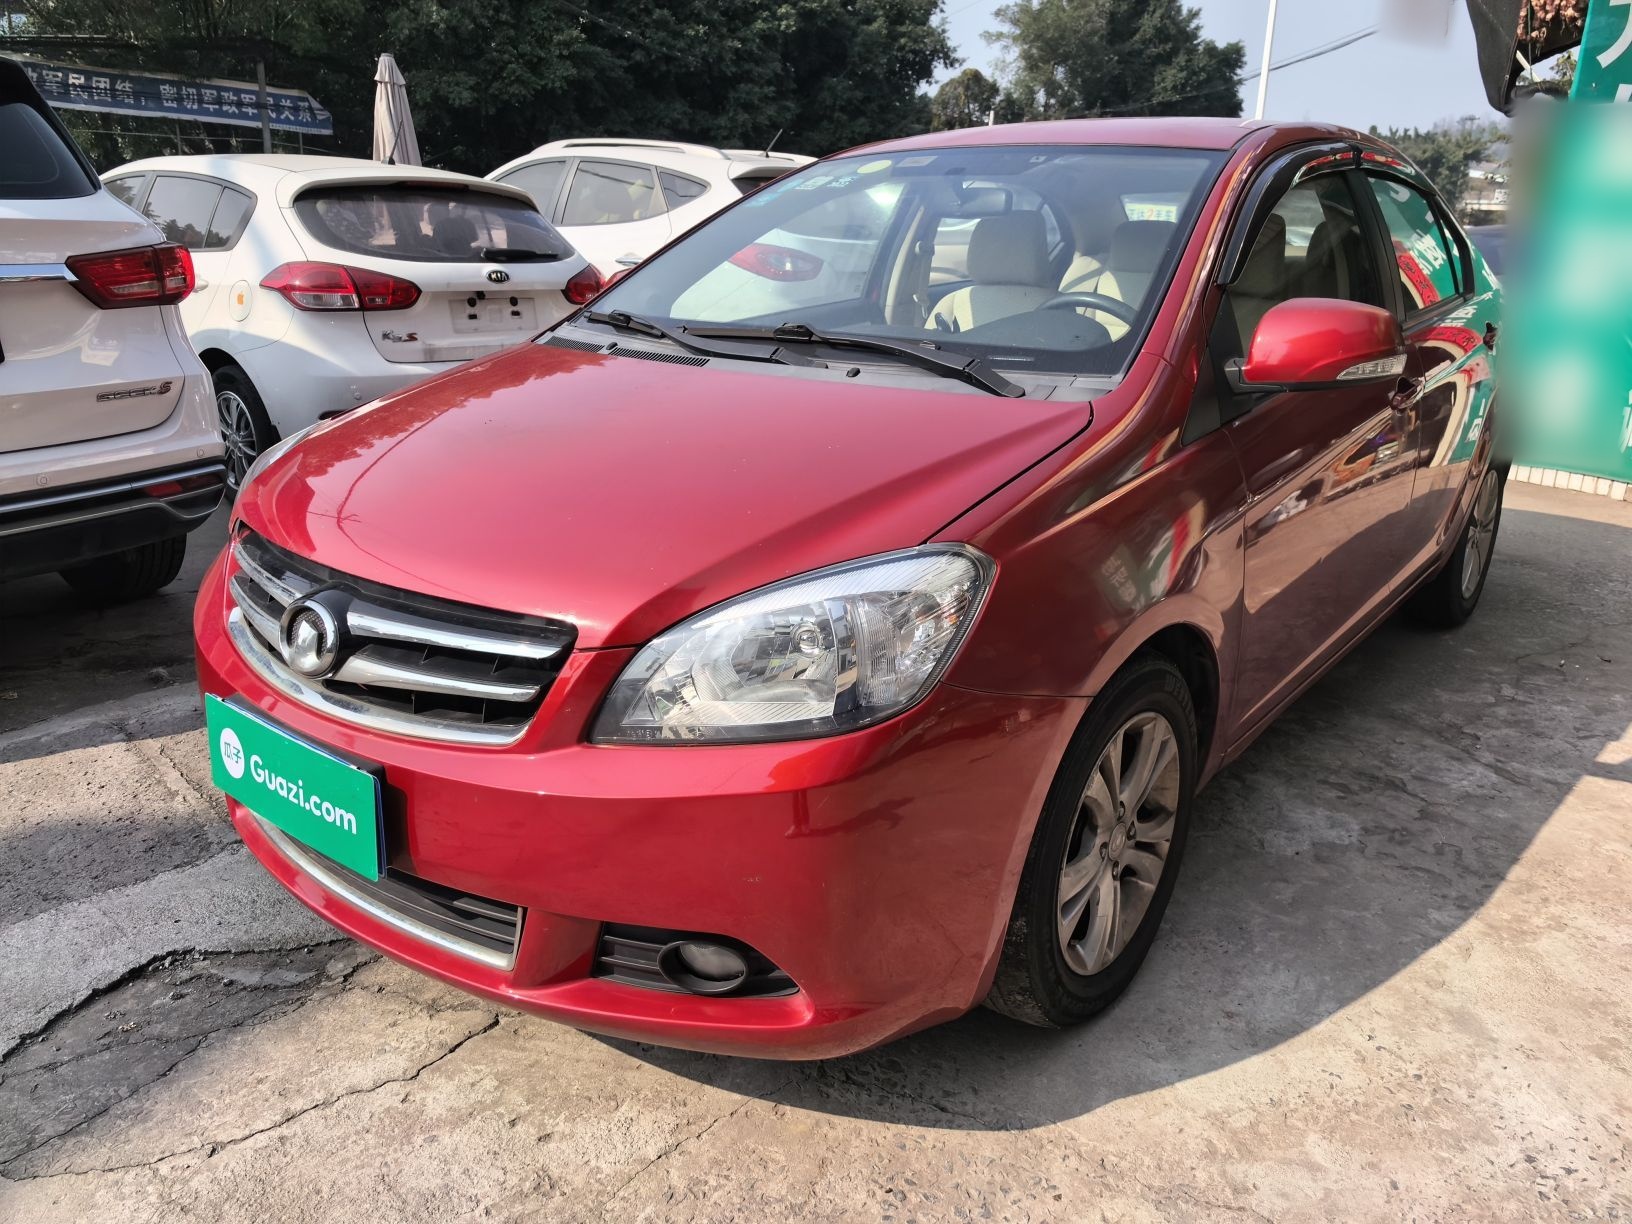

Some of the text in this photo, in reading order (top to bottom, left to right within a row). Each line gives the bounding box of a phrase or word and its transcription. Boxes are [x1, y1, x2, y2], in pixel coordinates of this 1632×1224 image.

[490, 271, 508, 281] KIA
[224, 741, 242, 765] 瓜子
[250, 754, 357, 835] Guazi.com
